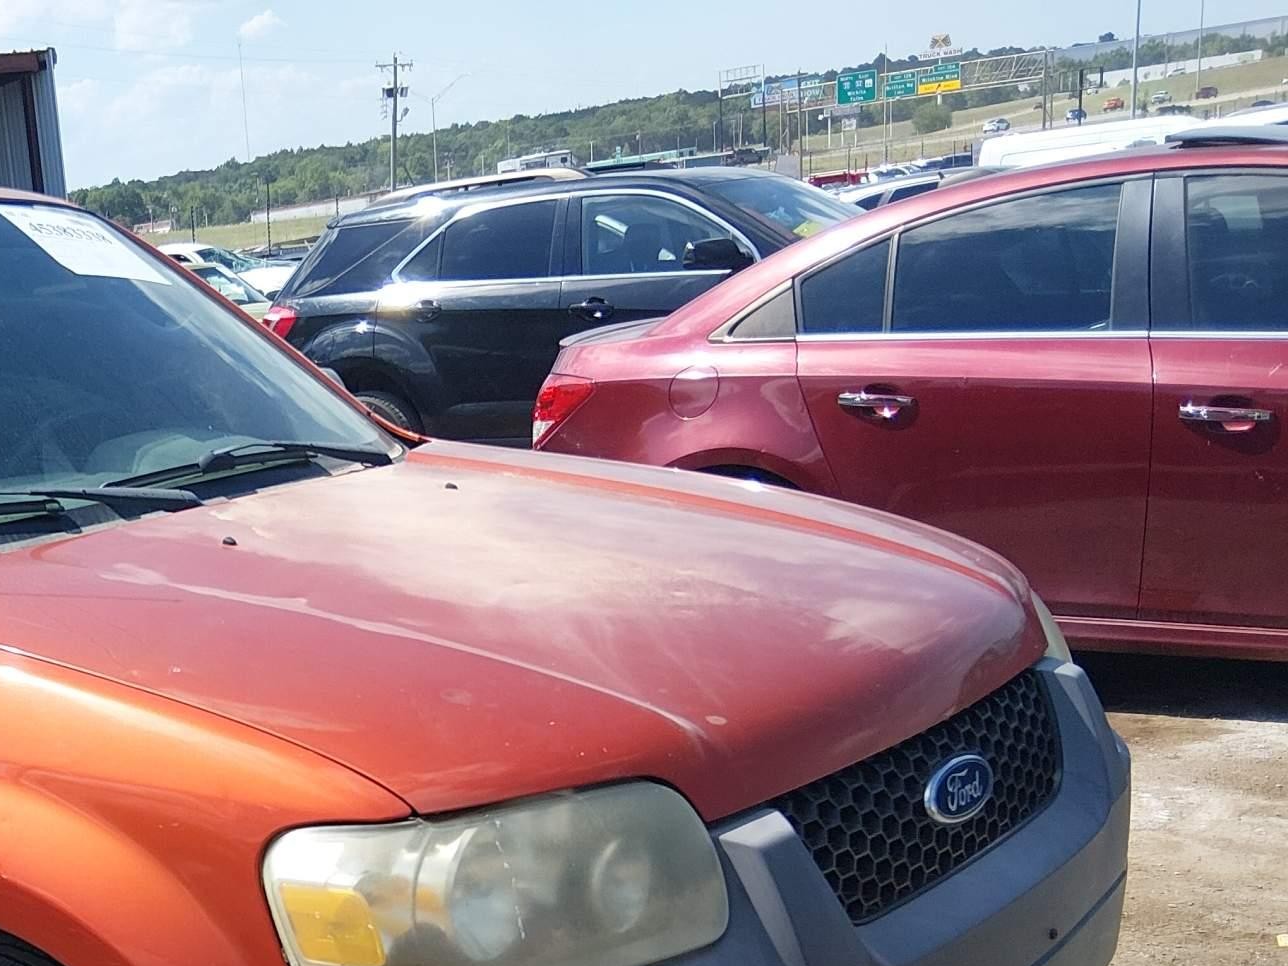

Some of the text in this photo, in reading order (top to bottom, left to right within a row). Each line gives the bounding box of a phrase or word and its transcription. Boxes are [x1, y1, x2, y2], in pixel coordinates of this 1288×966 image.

[919, 48, 963, 60] TRUCK WASH
[28, 222, 113, 245] 45383338
[946, 768, 984, 812] Ford
